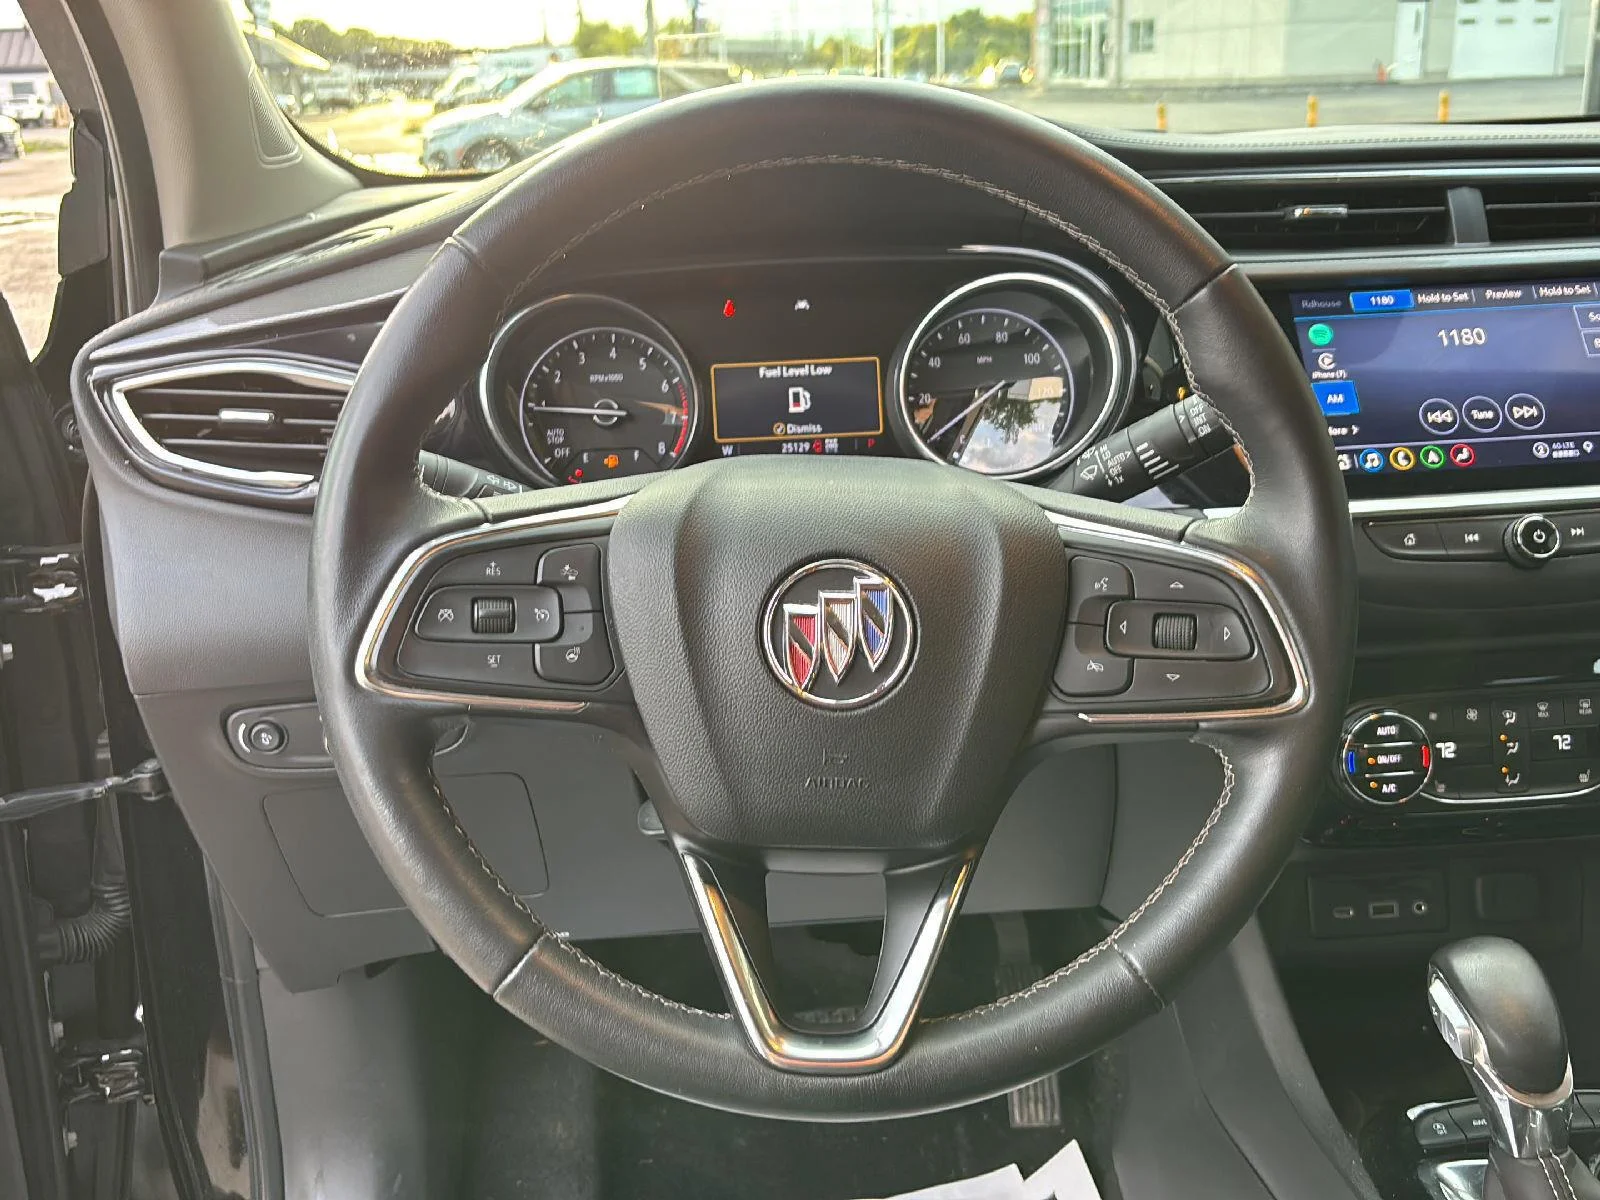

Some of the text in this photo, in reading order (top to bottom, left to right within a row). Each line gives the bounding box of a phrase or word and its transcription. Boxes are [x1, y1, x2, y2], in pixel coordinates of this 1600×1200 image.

[1485, 288, 1522, 300] Preview
[1539, 284, 1591, 297] Hold to Set
[1370, 294, 1394, 306] 1180
[1417, 291, 1468, 304] Hold to Set
[958, 332, 971, 345] 60
[995, 331, 1008, 343] 80
[1437, 327, 1486, 347] 1180
[578, 351, 586, 365] 3
[609, 347, 616, 359] 4
[1023, 352, 1040, 365] 100
[639, 357, 647, 371] 5
[928, 356, 941, 369] 40
[976, 355, 992, 364] MPH
[554, 370, 561, 384] 2
[759, 364, 832, 378] Fuel Level Low
[661, 380, 669, 393] 6
[918, 392, 931, 405] 20
[1327, 393, 1344, 404] AM
[1471, 408, 1494, 420] Tune
[547, 428, 565, 436] AUTO
[787, 423, 822, 434] Dismiss
[1197, 423, 1212, 438] ON
[782, 442, 810, 453] 25129
[867, 439, 876, 448] P
[554, 447, 571, 458] OFF
[721, 445, 733, 456] W
[1108, 452, 1125, 468] AUTO
[1110, 464, 1122, 477] OFF
[486, 567, 501, 576] RES
[487, 655, 501, 664] SET
[1376, 726, 1396, 736] AUTO
[1552, 735, 1571, 750] 72
[1435, 742, 1457, 758] 72
[1377, 755, 1401, 764] ON/OFF
[1382, 783, 1397, 793] A/C
